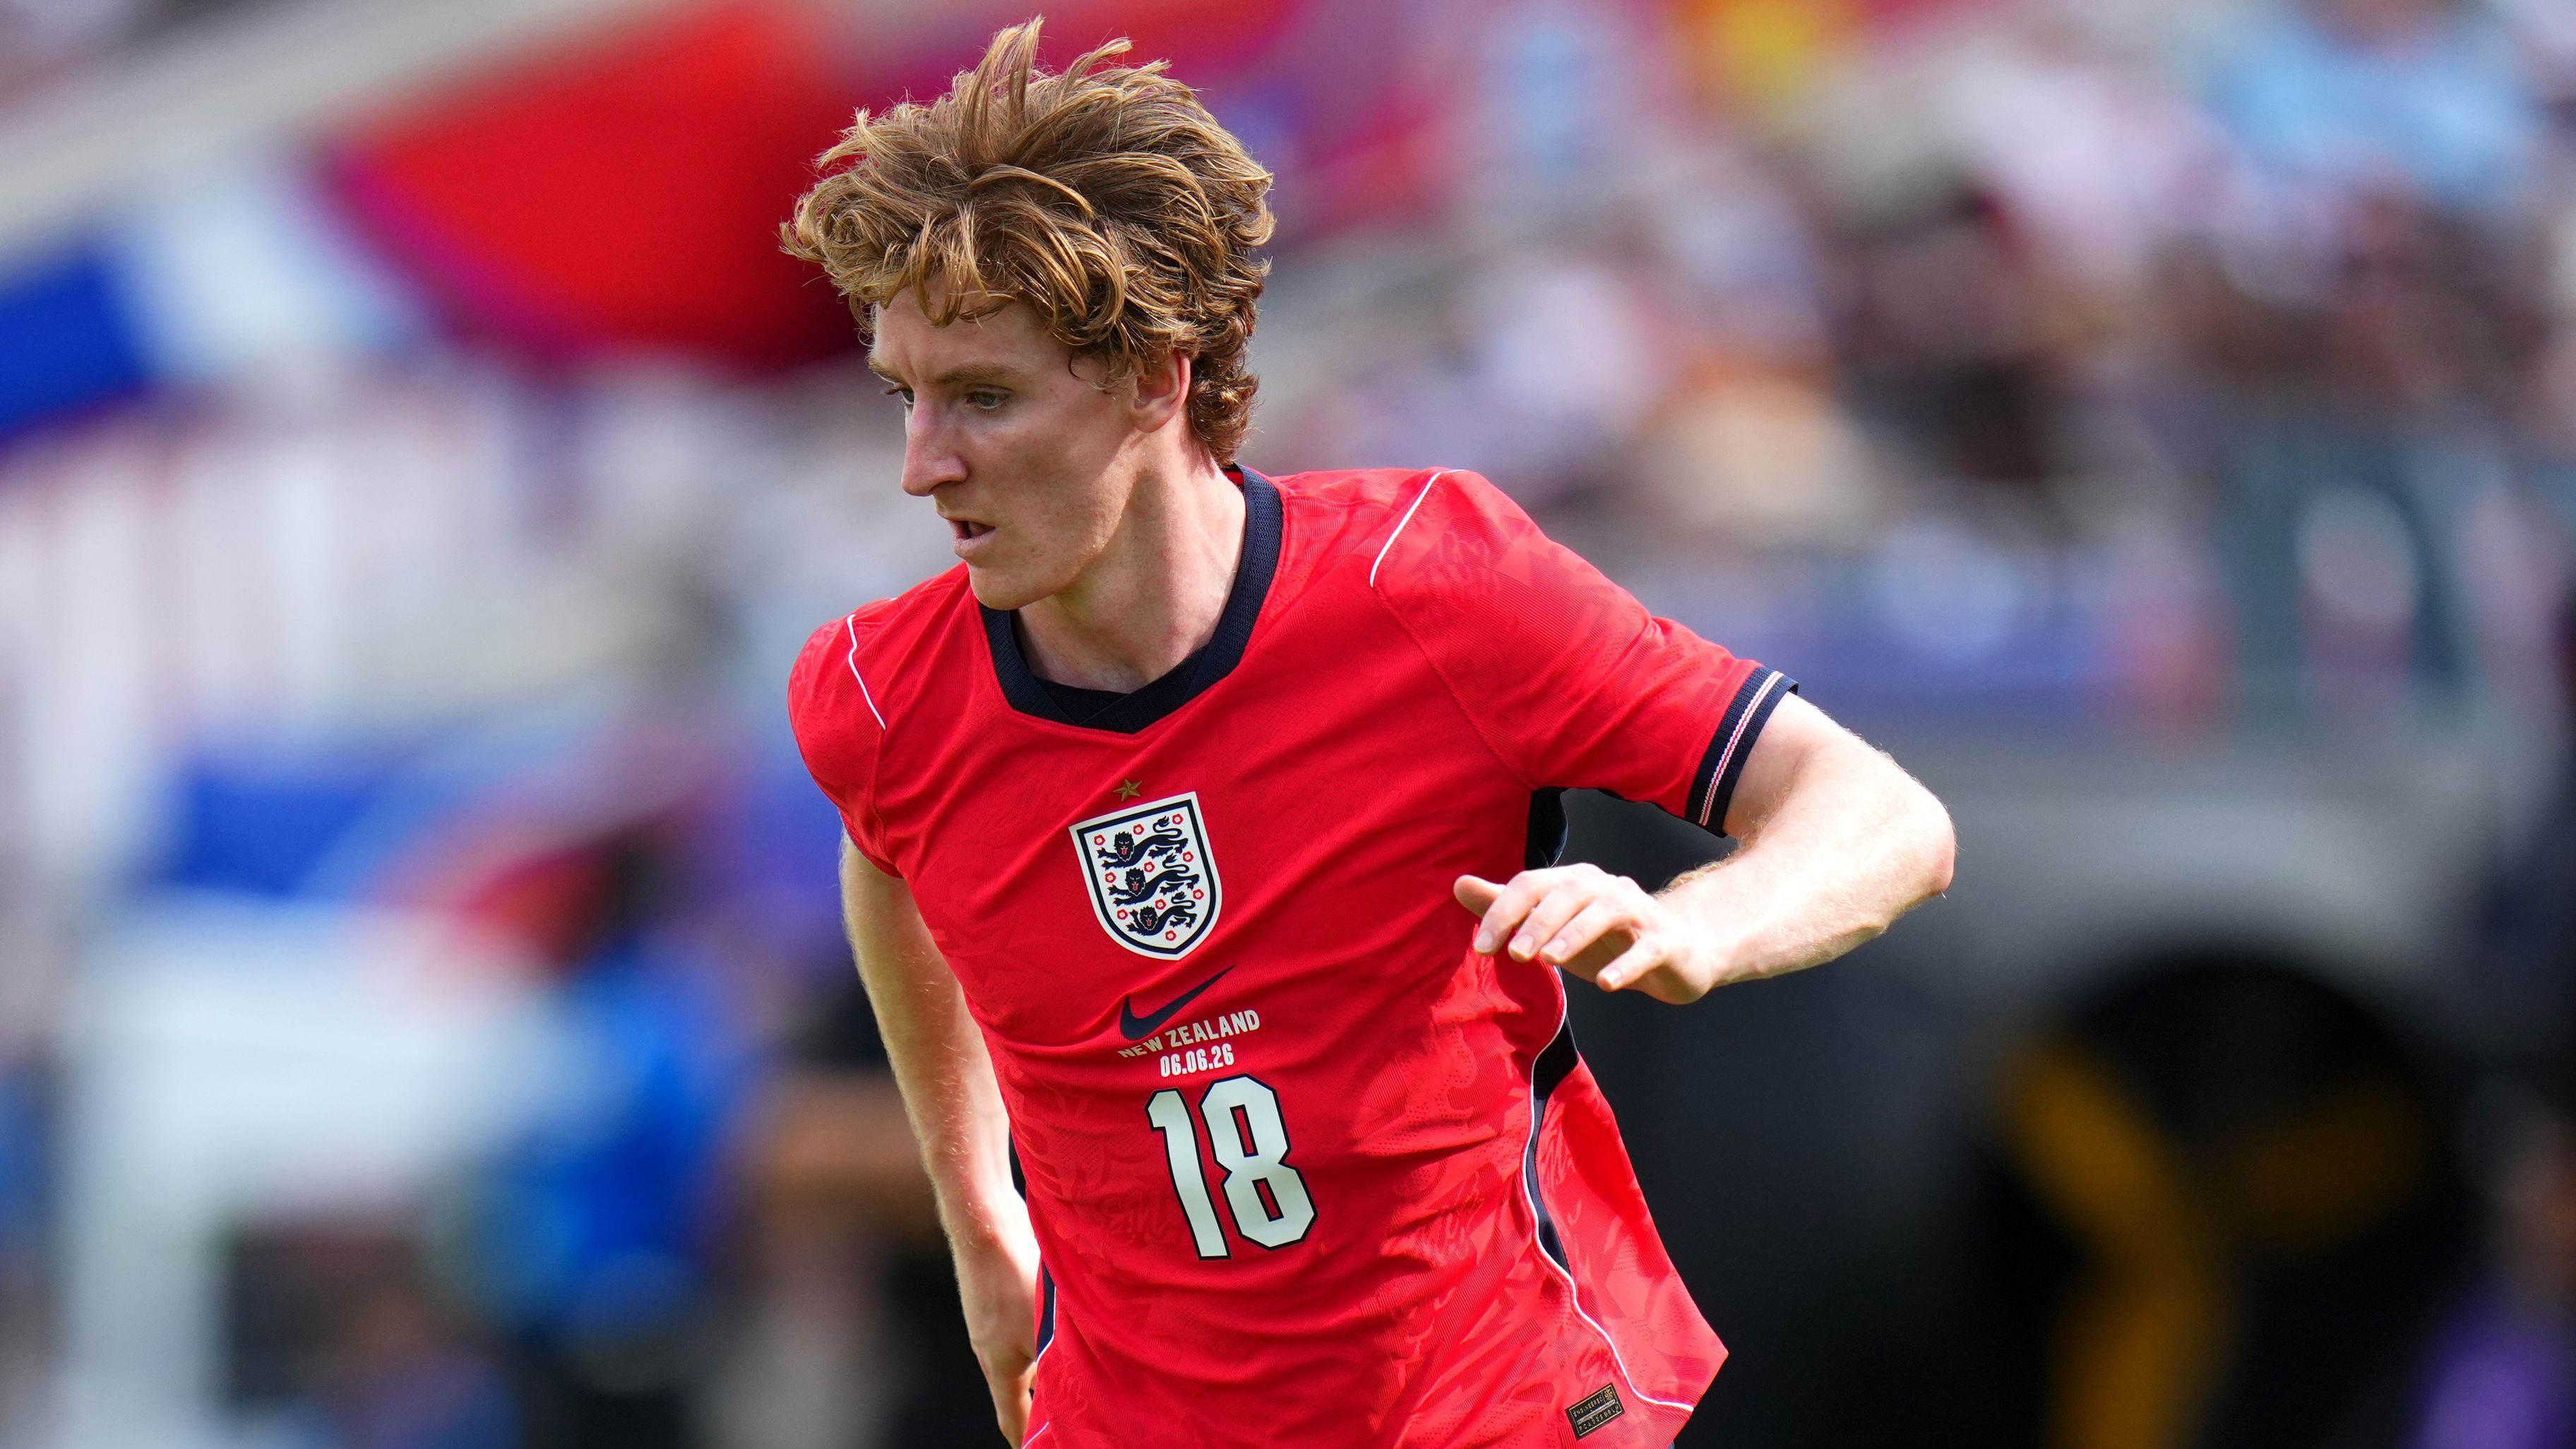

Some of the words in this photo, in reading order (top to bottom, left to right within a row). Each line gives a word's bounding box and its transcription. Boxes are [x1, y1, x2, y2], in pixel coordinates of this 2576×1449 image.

[1117, 1036, 1164, 1058] NEW
[1164, 1010, 1260, 1048] ZEALAND
[1159, 1043, 1234, 1078] 06.06.26
[1144, 1073, 1318, 1260] 18
